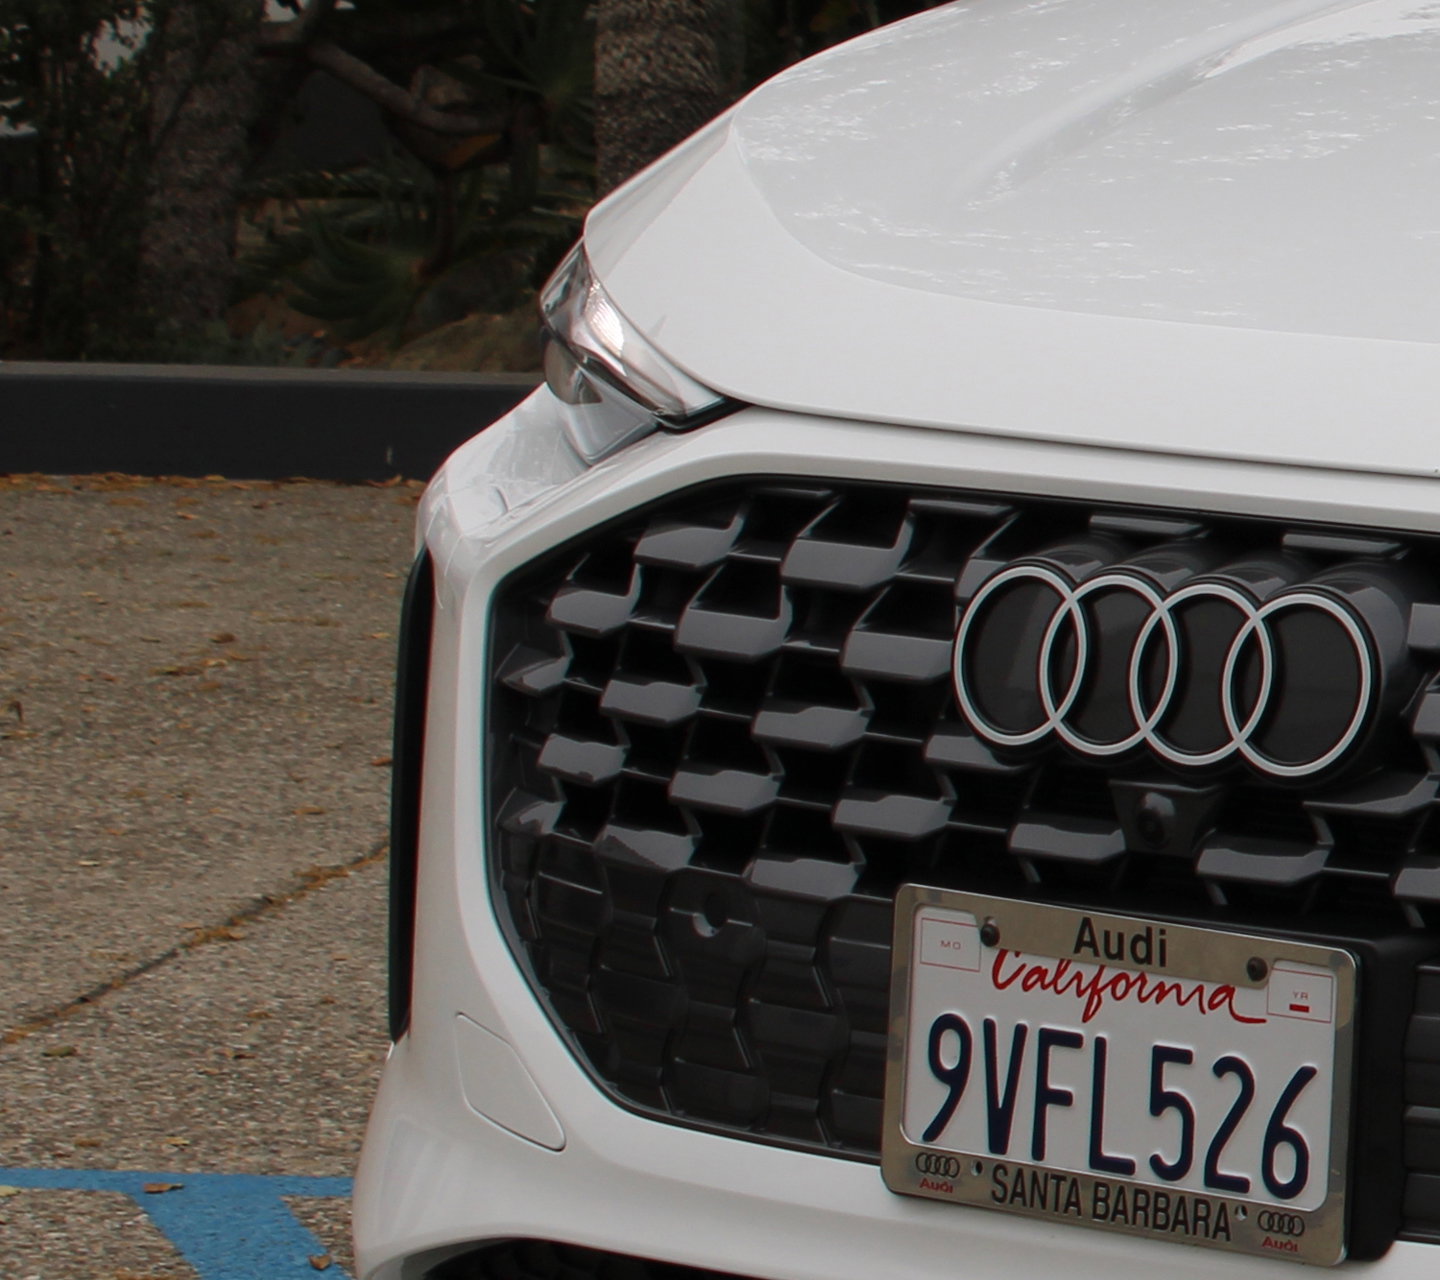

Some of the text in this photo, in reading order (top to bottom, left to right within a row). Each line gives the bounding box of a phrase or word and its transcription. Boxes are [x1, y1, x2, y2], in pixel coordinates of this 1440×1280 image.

[940, 939, 961, 950] MO
[1072, 917, 1167, 968] Audi
[992, 949, 1267, 1023] California
[1292, 990, 1309, 1001] YR
[921, 1012, 1318, 1201] 9VFL526
[919, 1177, 954, 1194] Audi
[990, 1163, 1232, 1242] SANTA BARBARA
[1261, 1236, 1299, 1253] Audi
